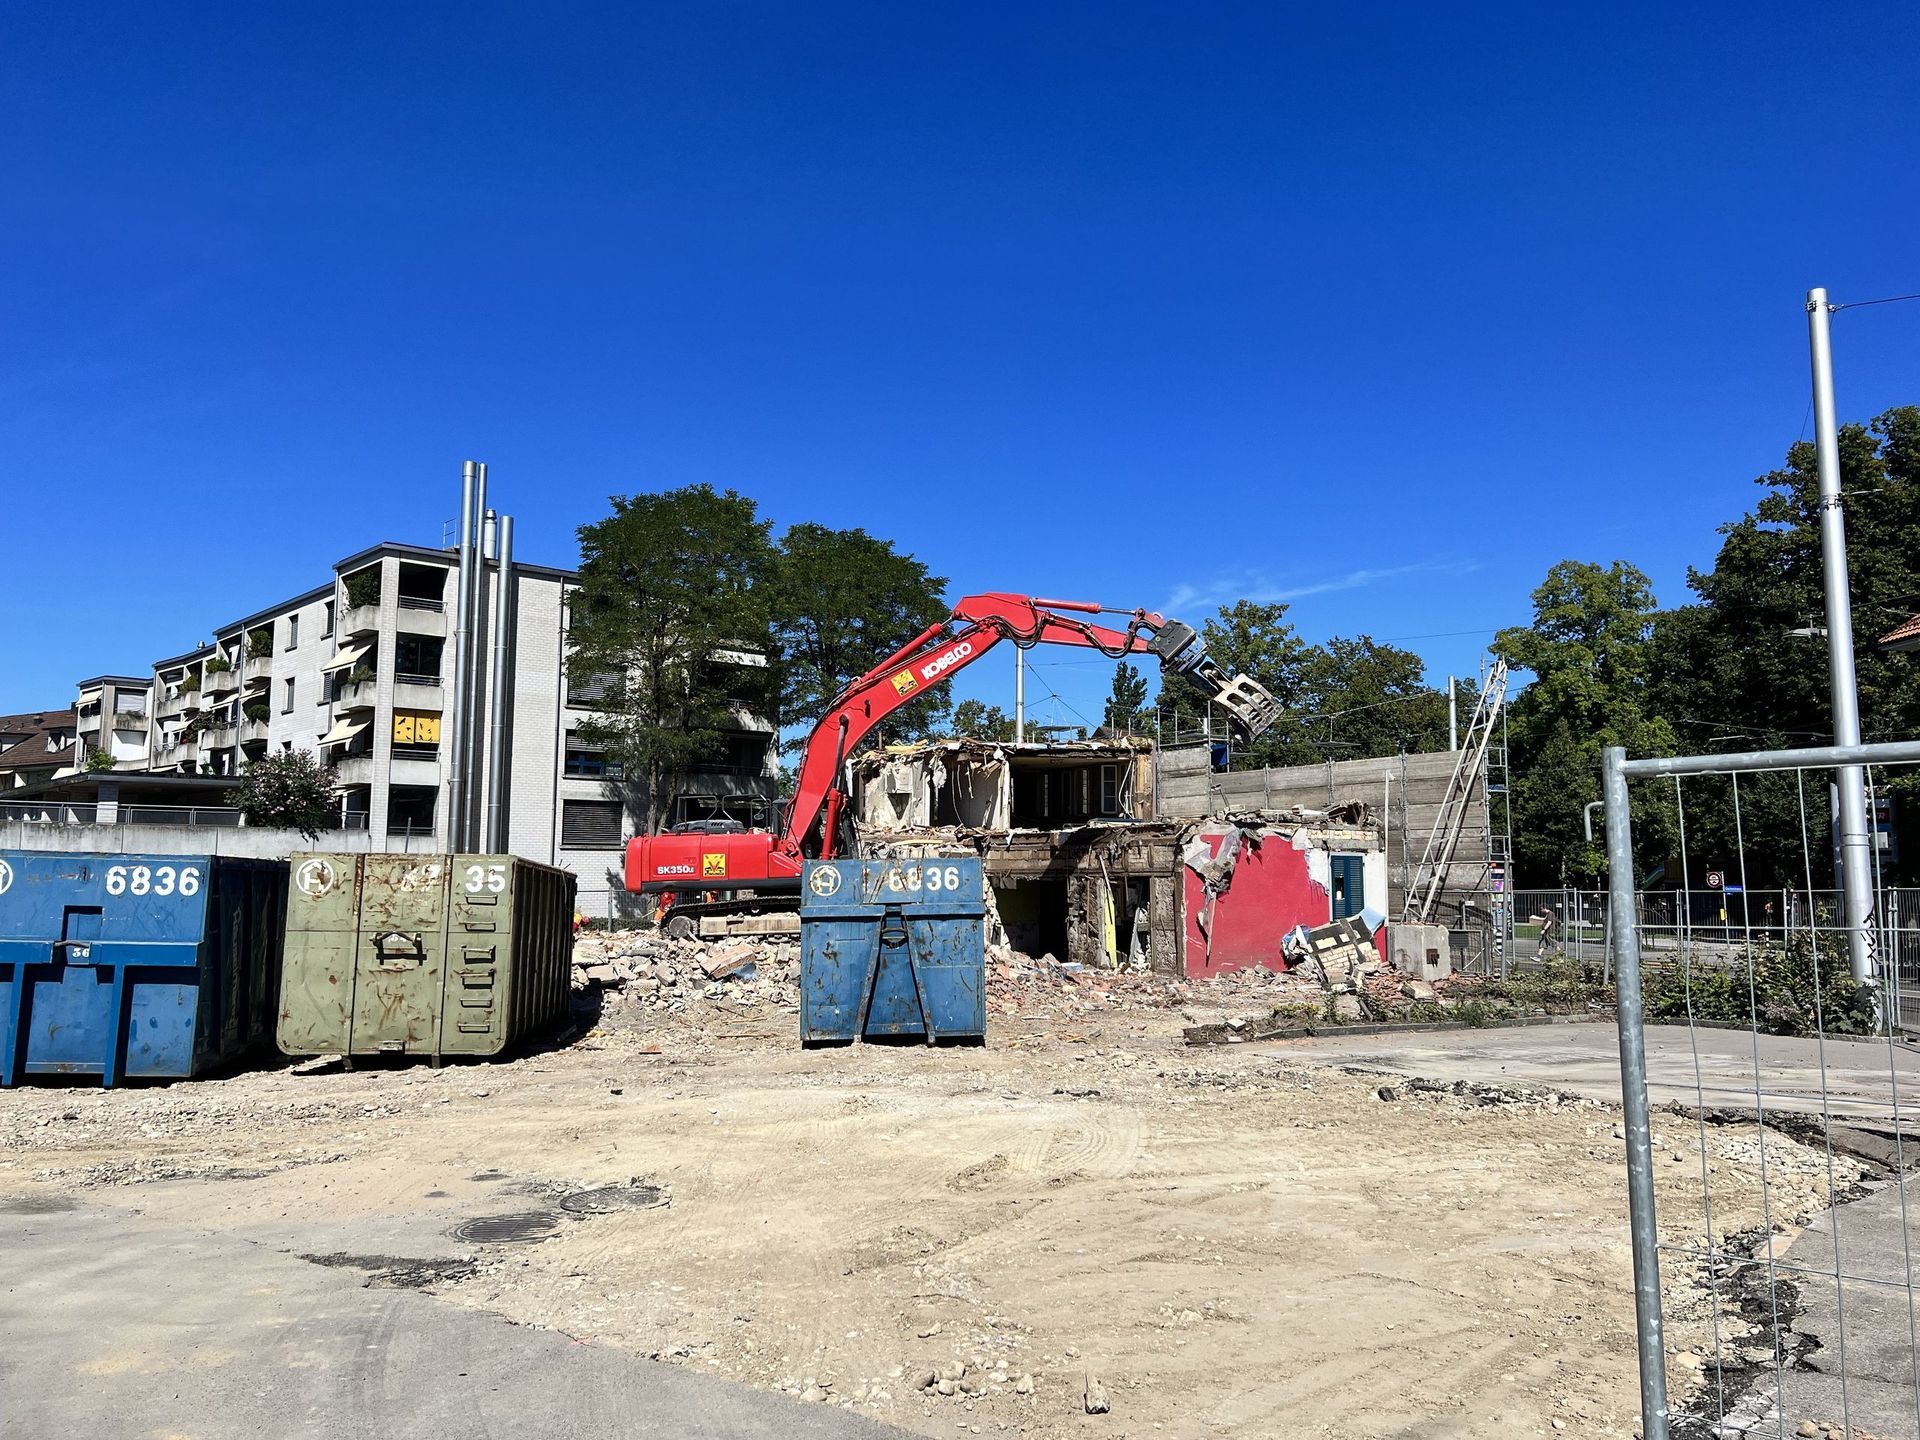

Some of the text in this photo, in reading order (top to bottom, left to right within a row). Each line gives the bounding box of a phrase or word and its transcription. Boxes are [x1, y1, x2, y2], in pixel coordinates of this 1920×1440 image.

[920, 642, 972, 680] KOBELCO
[105, 865, 200, 897] 6836
[888, 866, 960, 893] 6836
[72, 947, 90, 958] 36
